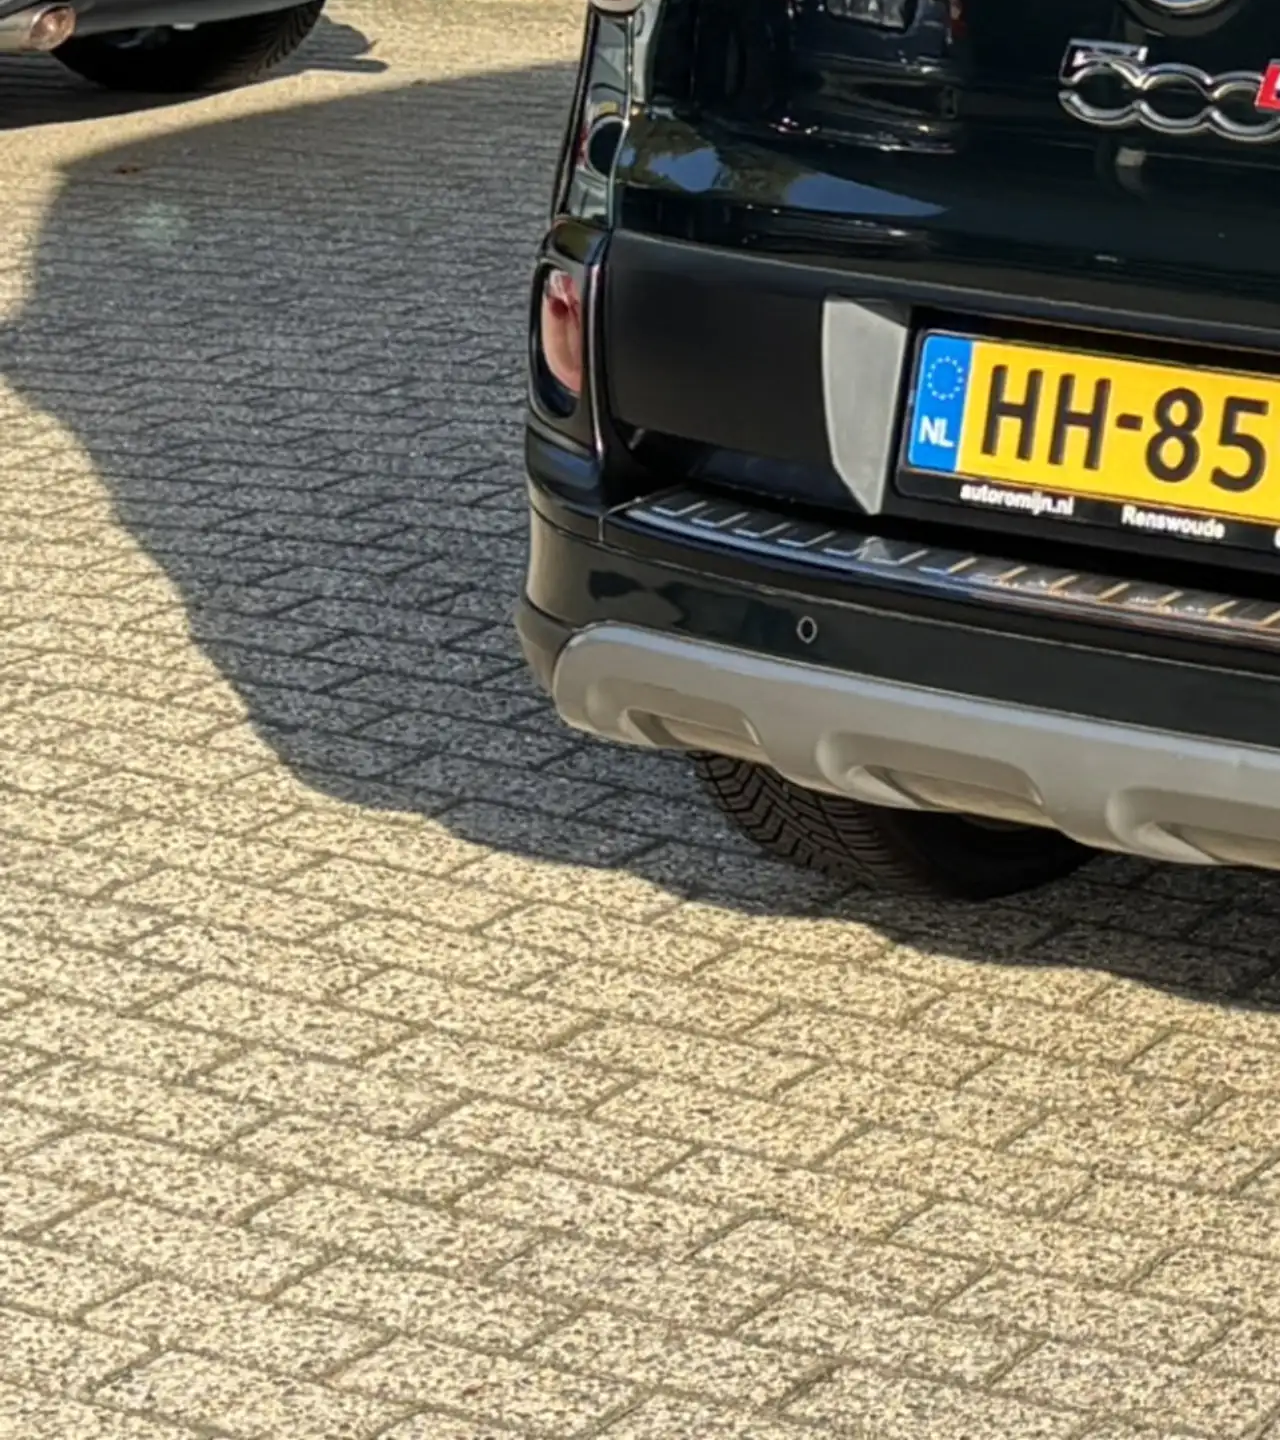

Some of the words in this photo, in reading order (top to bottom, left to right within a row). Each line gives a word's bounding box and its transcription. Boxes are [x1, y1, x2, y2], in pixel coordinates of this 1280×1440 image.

[919, 415, 954, 448] NL
[960, 483, 1075, 516] autoromijn.nl
[1121, 504, 1226, 539] Renswoude
